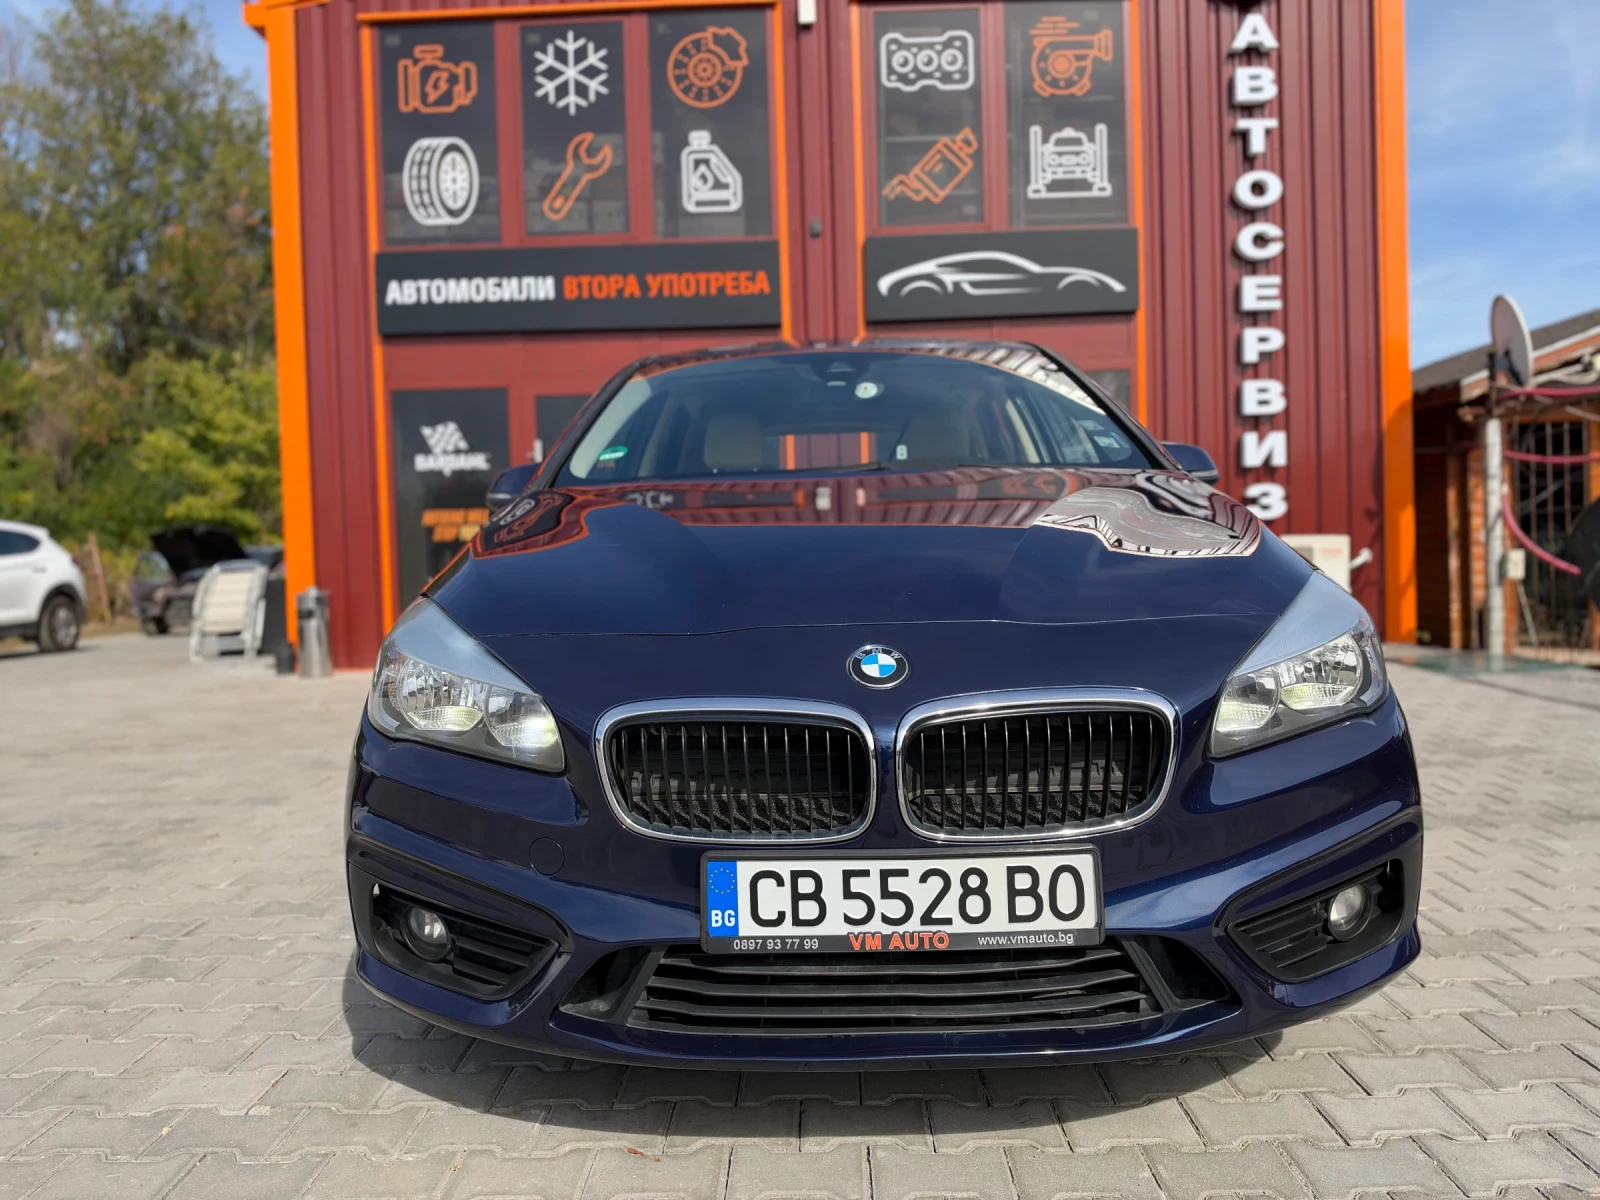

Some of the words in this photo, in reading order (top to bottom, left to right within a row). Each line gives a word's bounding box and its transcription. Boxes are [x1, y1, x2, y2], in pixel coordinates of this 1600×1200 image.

[1230, 13, 1288, 520] АВТОСЕРВИЗ
[384, 275, 556, 306] АВТОМОБИЛИ
[562, 273, 642, 300] ВТОРА
[645, 269, 771, 299] УПОТРЕБА
[749, 869, 827, 928] CB
[841, 867, 992, 926] 5528
[711, 909, 736, 928] BG
[733, 939, 763, 950] 0897
[766, 939, 782, 950] 93
[785, 939, 800, 949] 77
[803, 938, 819, 949] 99
[849, 932, 883, 950] VM
[888, 931, 950, 949] AUTO
[977, 932, 1074, 946] www.vmauto.bg
